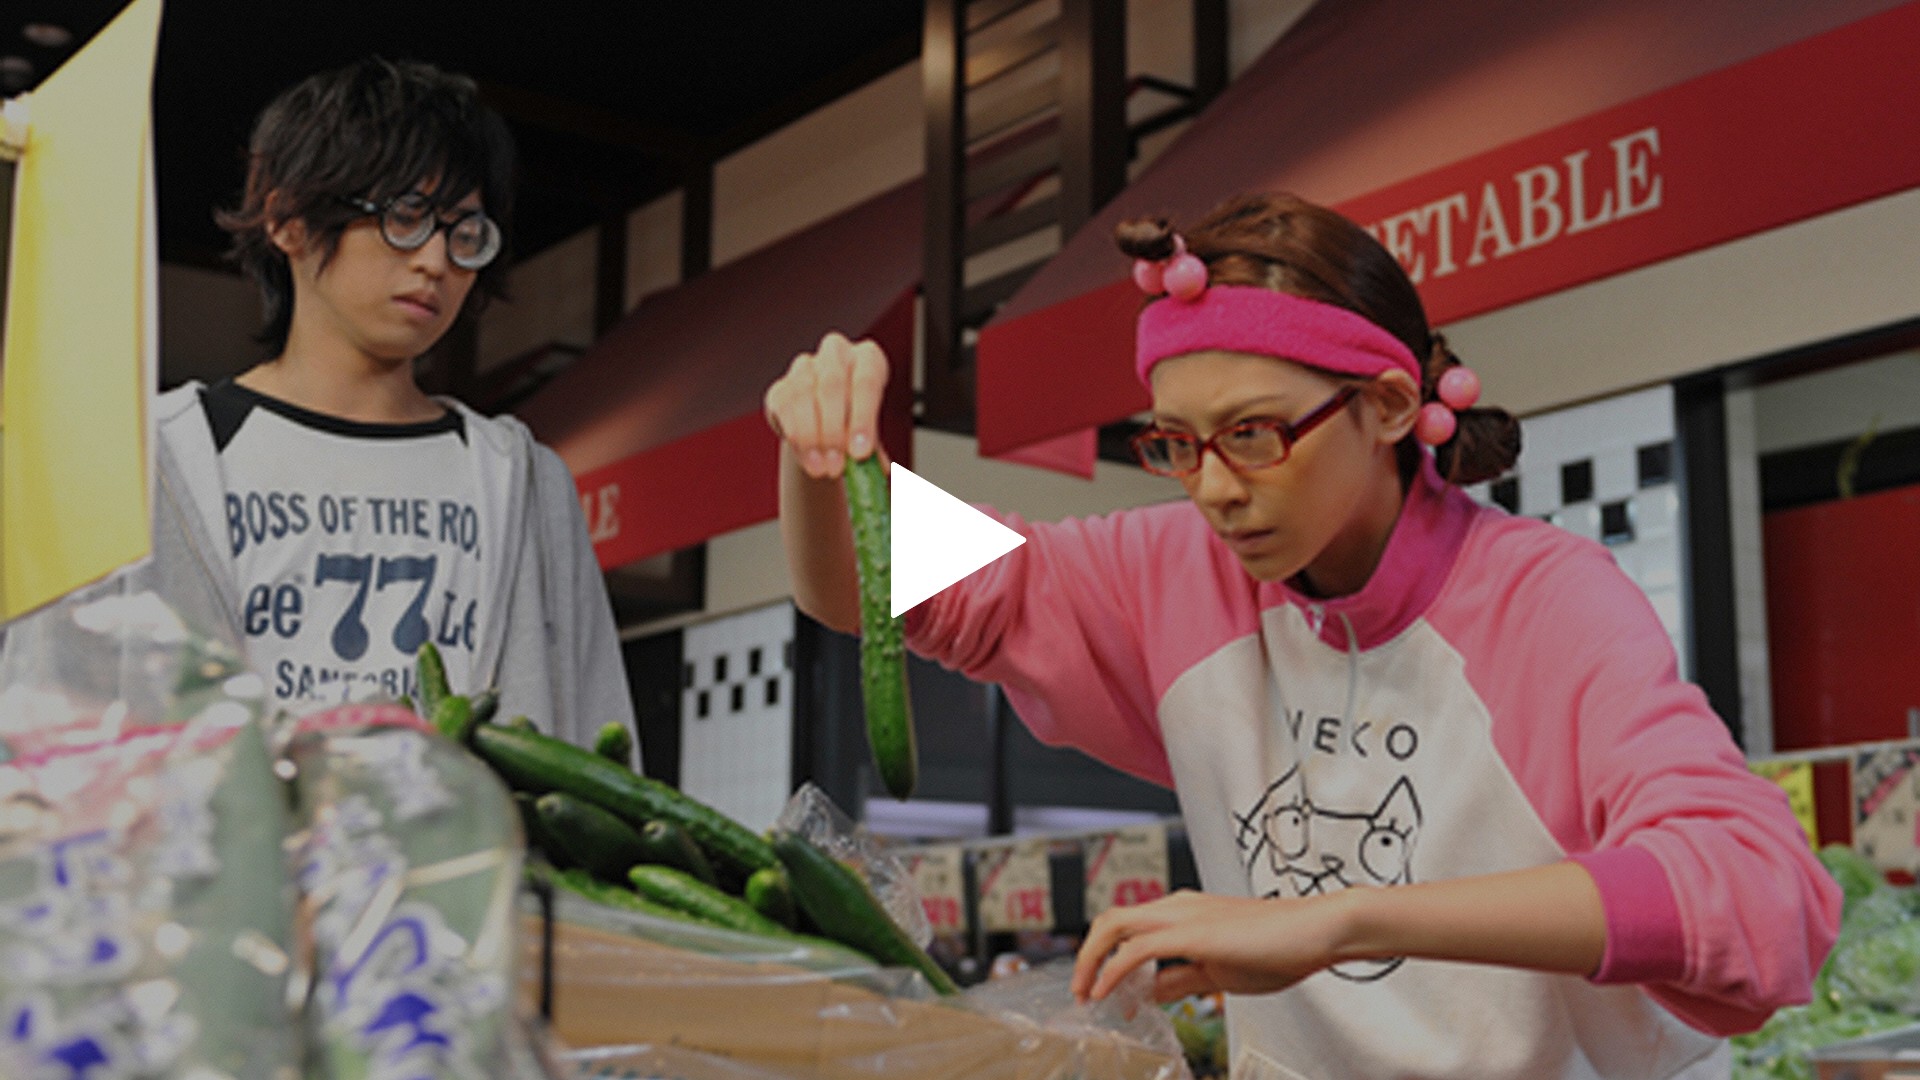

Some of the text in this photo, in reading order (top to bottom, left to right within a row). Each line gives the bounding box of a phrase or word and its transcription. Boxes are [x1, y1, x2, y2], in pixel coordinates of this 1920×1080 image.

[1366, 126, 1662, 286] ETABLE
[225, 491, 480, 561] BOSS OF THE RO
[314, 553, 437, 662] 77
